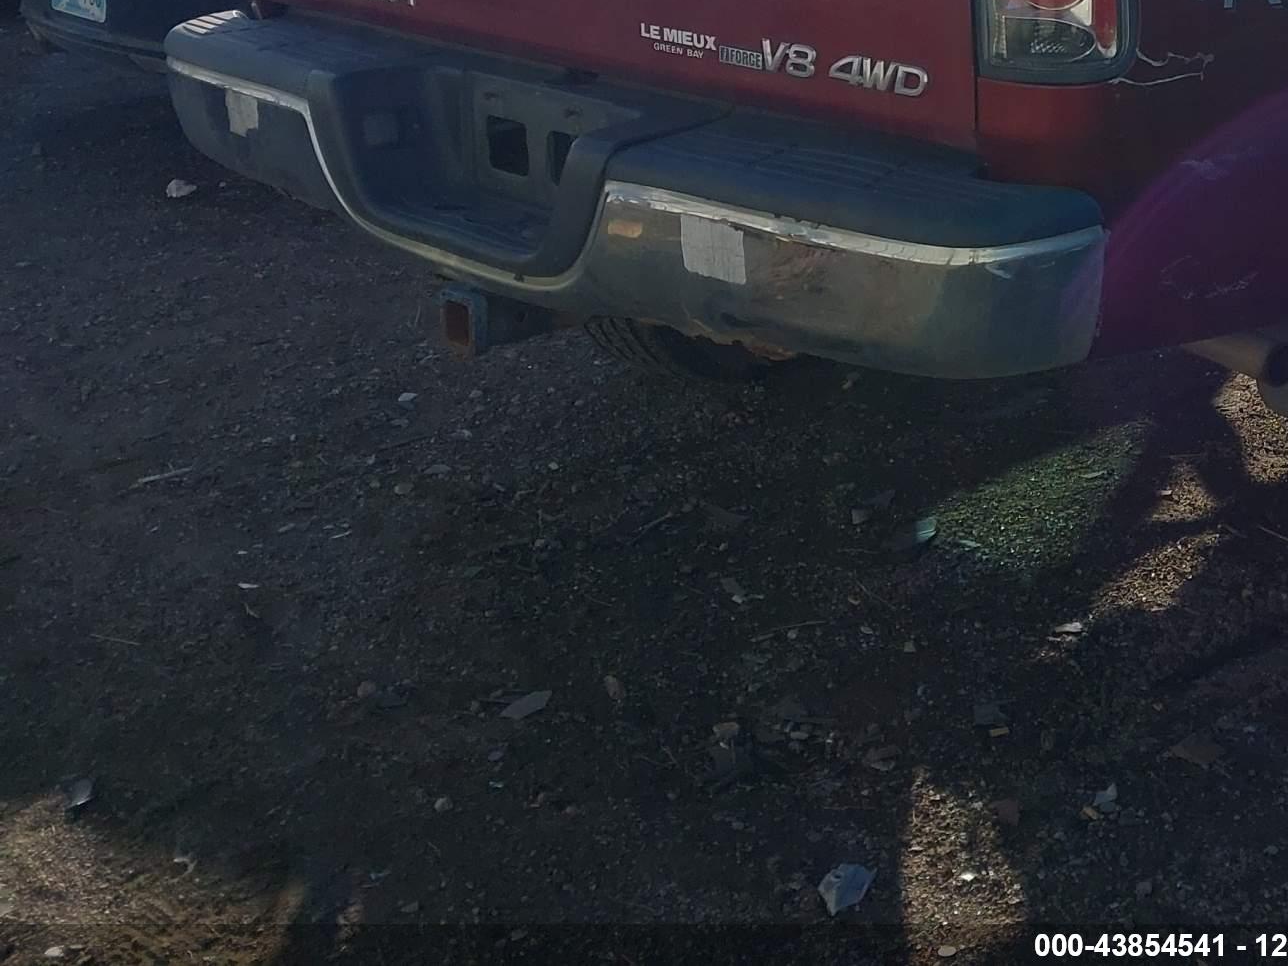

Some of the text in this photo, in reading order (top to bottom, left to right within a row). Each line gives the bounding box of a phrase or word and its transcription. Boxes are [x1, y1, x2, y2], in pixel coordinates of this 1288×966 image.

[640, 22, 717, 51] LE MIEUX
[653, 42, 705, 59] GREEN BAY
[761, 37, 817, 78] V8
[827, 54, 929, 97] 4WD
